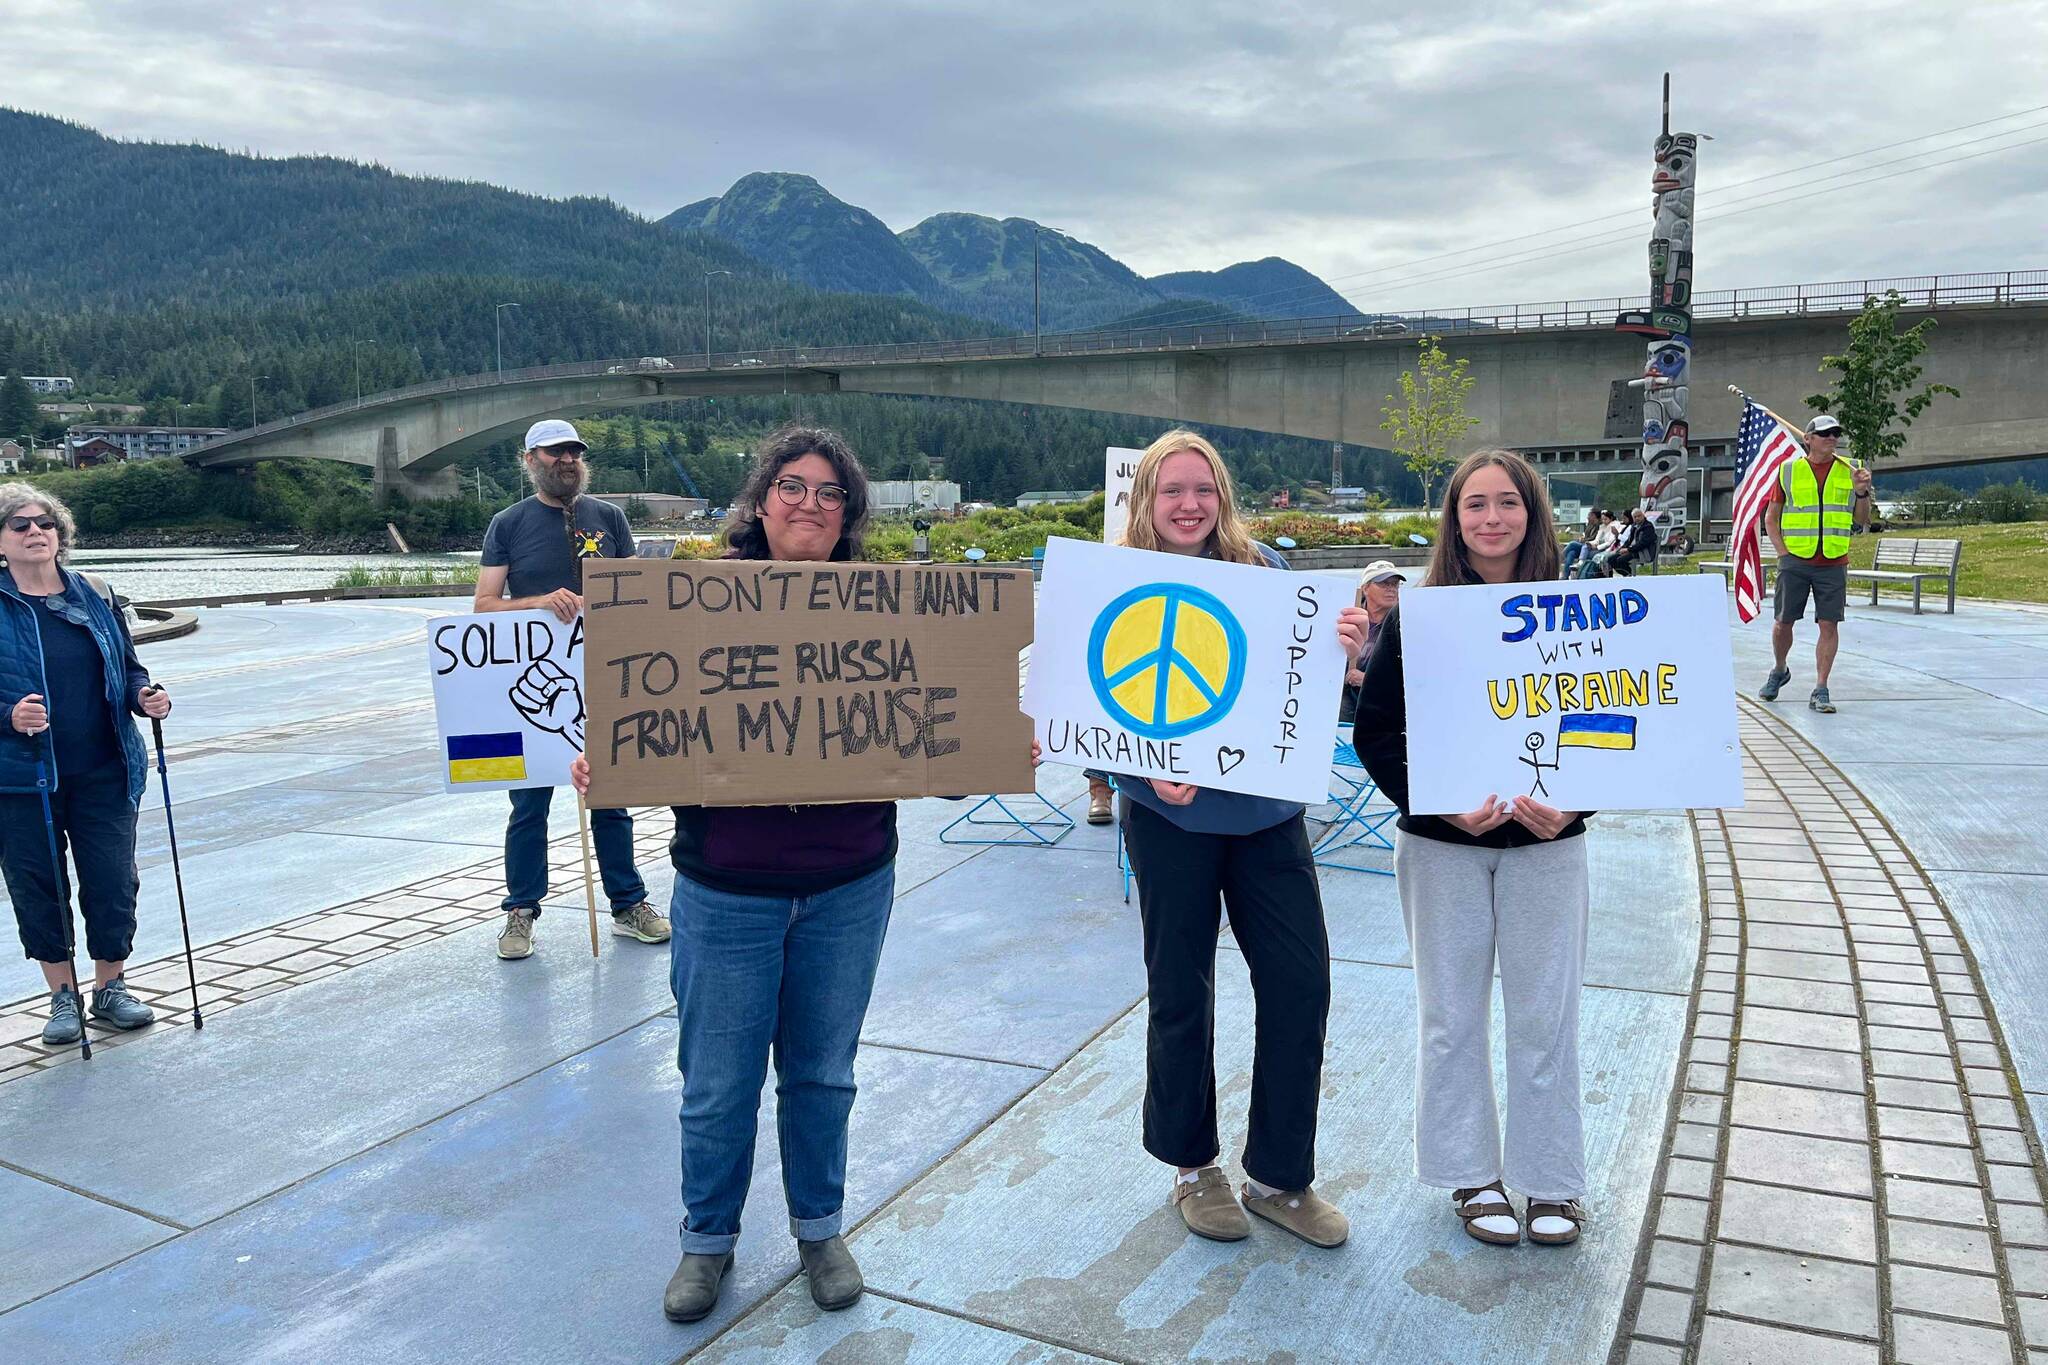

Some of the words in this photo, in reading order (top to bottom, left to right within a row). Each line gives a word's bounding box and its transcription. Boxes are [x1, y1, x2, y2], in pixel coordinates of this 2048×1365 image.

[590, 572, 648, 609] I
[668, 566, 802, 613] DON'T
[809, 570, 900, 614] EVEN
[914, 571, 1016, 616] WANT
[1501, 588, 1649, 643] STAND
[607, 651, 680, 698] TO
[700, 644, 778, 695] SEE
[796, 638, 917, 684] RUSSIA
[1274, 585, 1319, 764] SUPPORT
[1537, 638, 1604, 665] WITH
[1487, 663, 1679, 720] UKRAINE
[611, 707, 714, 766] FROM
[737, 697, 801, 756] MY
[818, 687, 961, 760] HOUSE
[1047, 718, 1190, 774] UKRAINE
